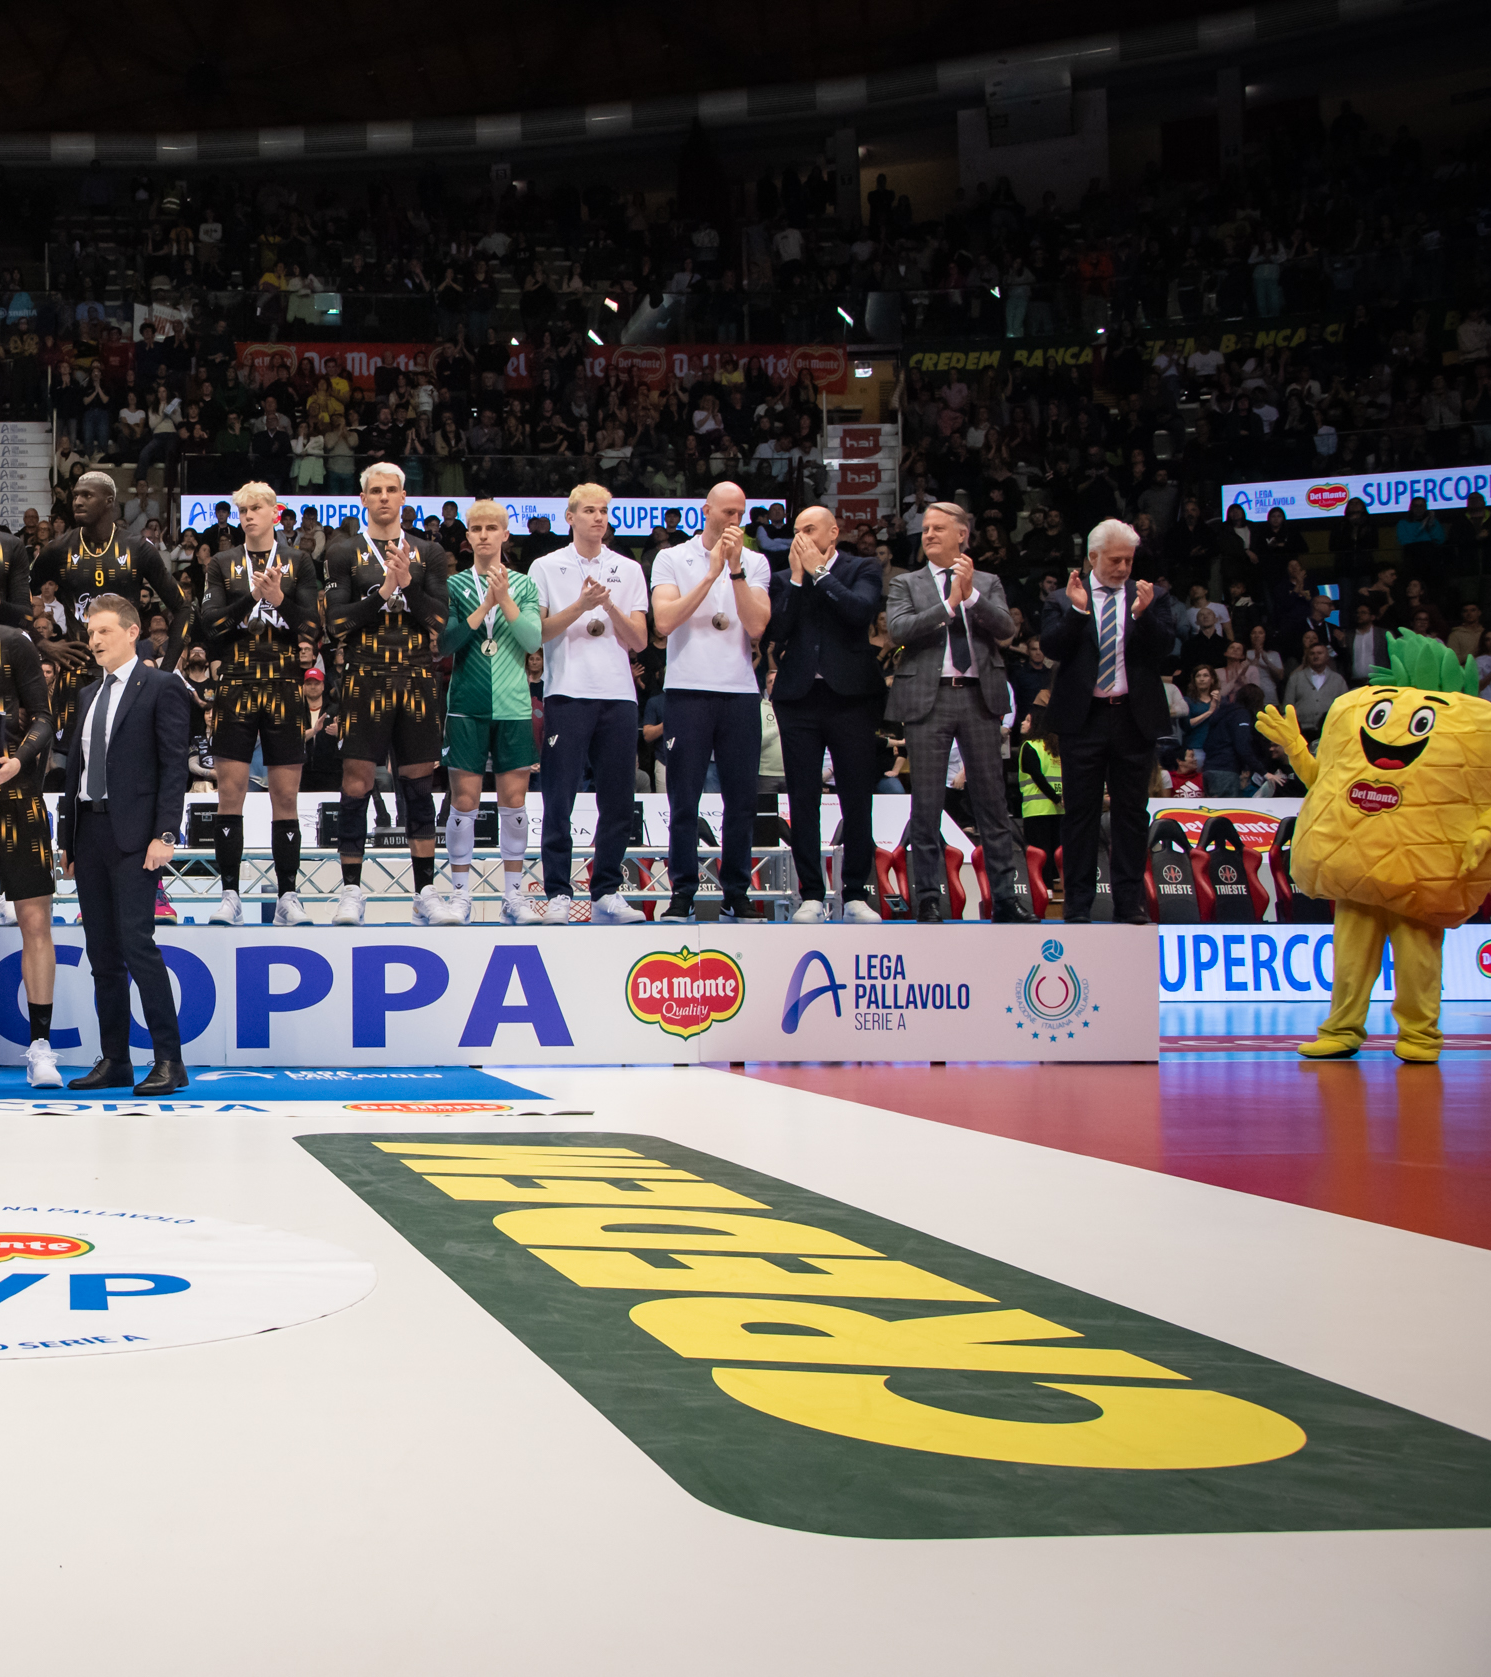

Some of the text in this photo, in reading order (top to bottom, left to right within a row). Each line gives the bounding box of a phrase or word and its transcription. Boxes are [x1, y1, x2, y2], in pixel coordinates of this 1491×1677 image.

[908, 349, 1002, 372] CREDEM
[1255, 490, 1273, 499] LEGA
[1310, 491, 1347, 500] Del Monte
[1363, 474, 1491, 507] SUPERCOP
[1255, 496, 1296, 506] PALLAVOLO
[95, 570, 105, 587] 9
[1350, 788, 1399, 805] Del Monte
[1159, 884, 1193, 895] TRIESTE
[1215, 885, 1248, 895] TRIESTE
[854, 955, 907, 981] LEGA
[637, 976, 737, 999] Del Monte
[854, 984, 971, 1011] PALLAVOLO
[1015, 978, 1038, 1025] FEDERAZIONE
[1074, 978, 1090, 1018] PALLAVOLO
[662, 1001, 709, 1021] Quality
[854, 1012, 907, 1031] SERIE A
[1041, 1018, 1073, 1030] ITALIANA
[47, 1207, 196, 1225] PALLAVOLO
[370, 1141, 1308, 1470] CREDEM
[18, 1334, 118, 1350] SERIE
[121, 1334, 150, 1342] A
